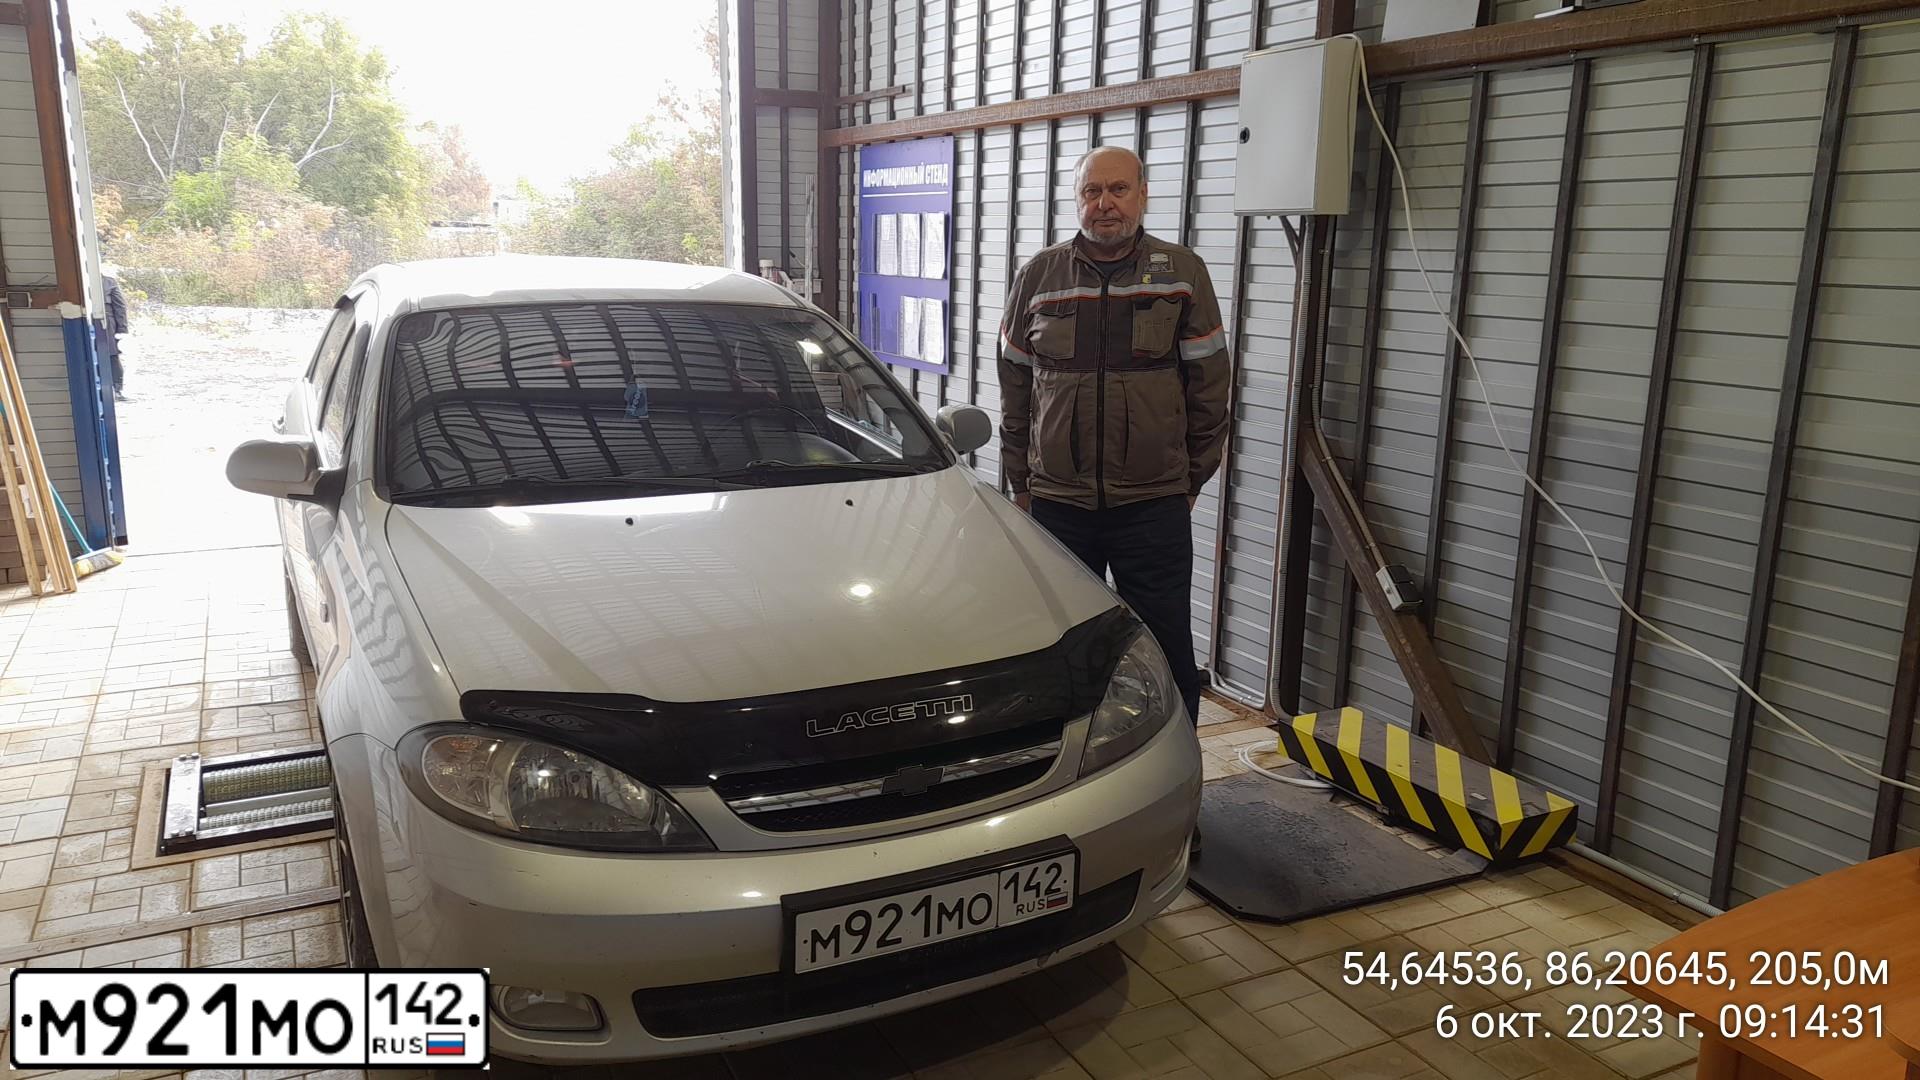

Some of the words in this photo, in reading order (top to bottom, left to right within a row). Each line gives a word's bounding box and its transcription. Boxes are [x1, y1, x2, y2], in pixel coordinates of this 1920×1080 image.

[863, 161, 925, 189] ИНФОРМАЦИОННЫЙ
[925, 163, 949, 187] СТЕНД
[805, 693, 975, 738] LACETTI
[809, 892, 993, 964] М921МО
[1003, 862, 1064, 905] 142
[1015, 900, 1046, 917] RUS
